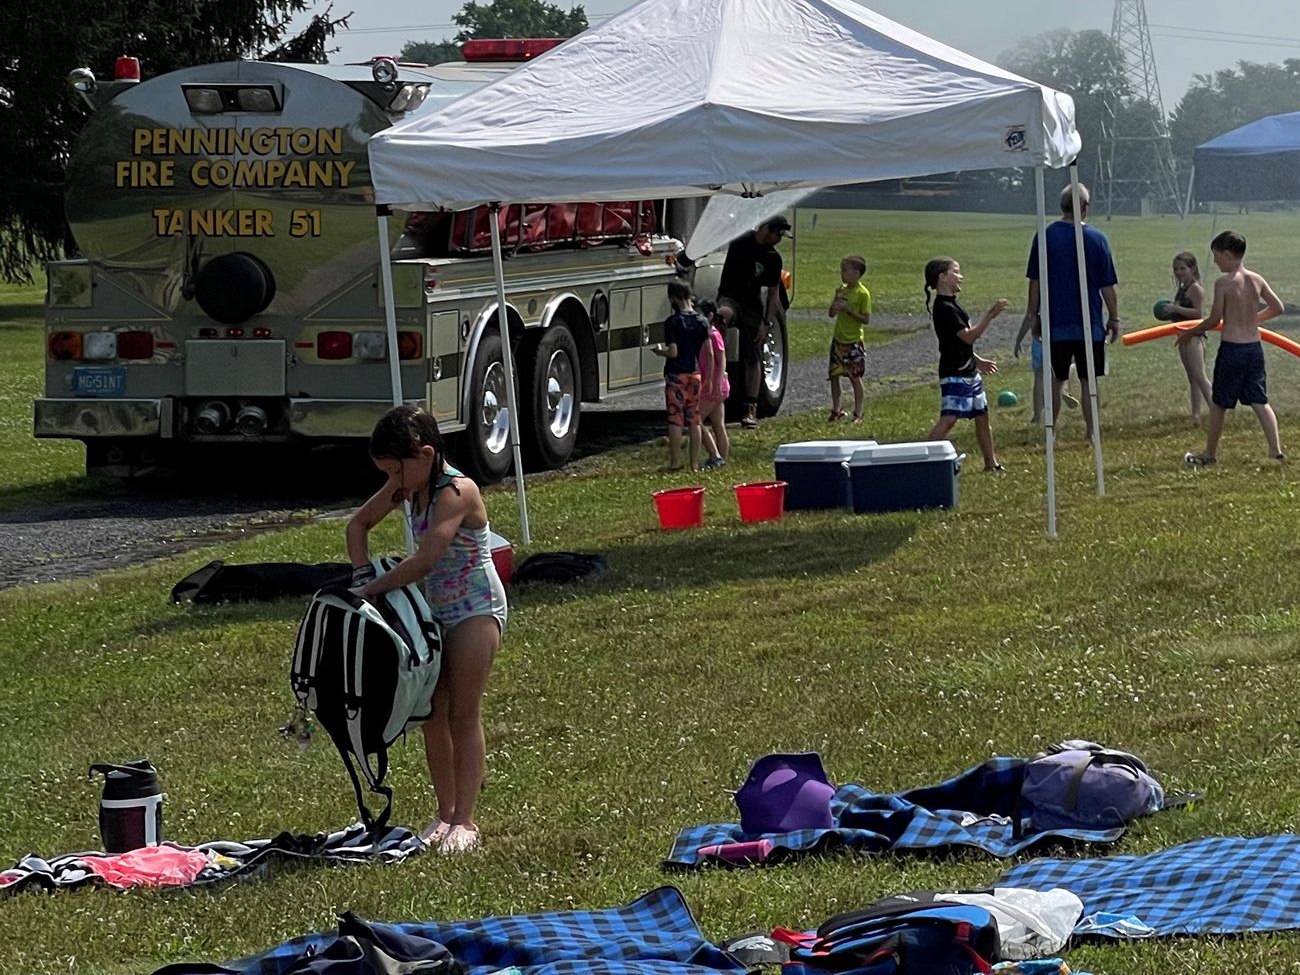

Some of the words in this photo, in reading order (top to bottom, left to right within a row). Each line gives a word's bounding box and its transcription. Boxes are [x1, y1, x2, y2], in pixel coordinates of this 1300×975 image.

[133, 128, 342, 155] PENNINGTON
[115, 160, 175, 187] FIRE
[190, 159, 356, 187] COMPANY
[153, 208, 275, 236] TANKER
[290, 209, 321, 236] 51
